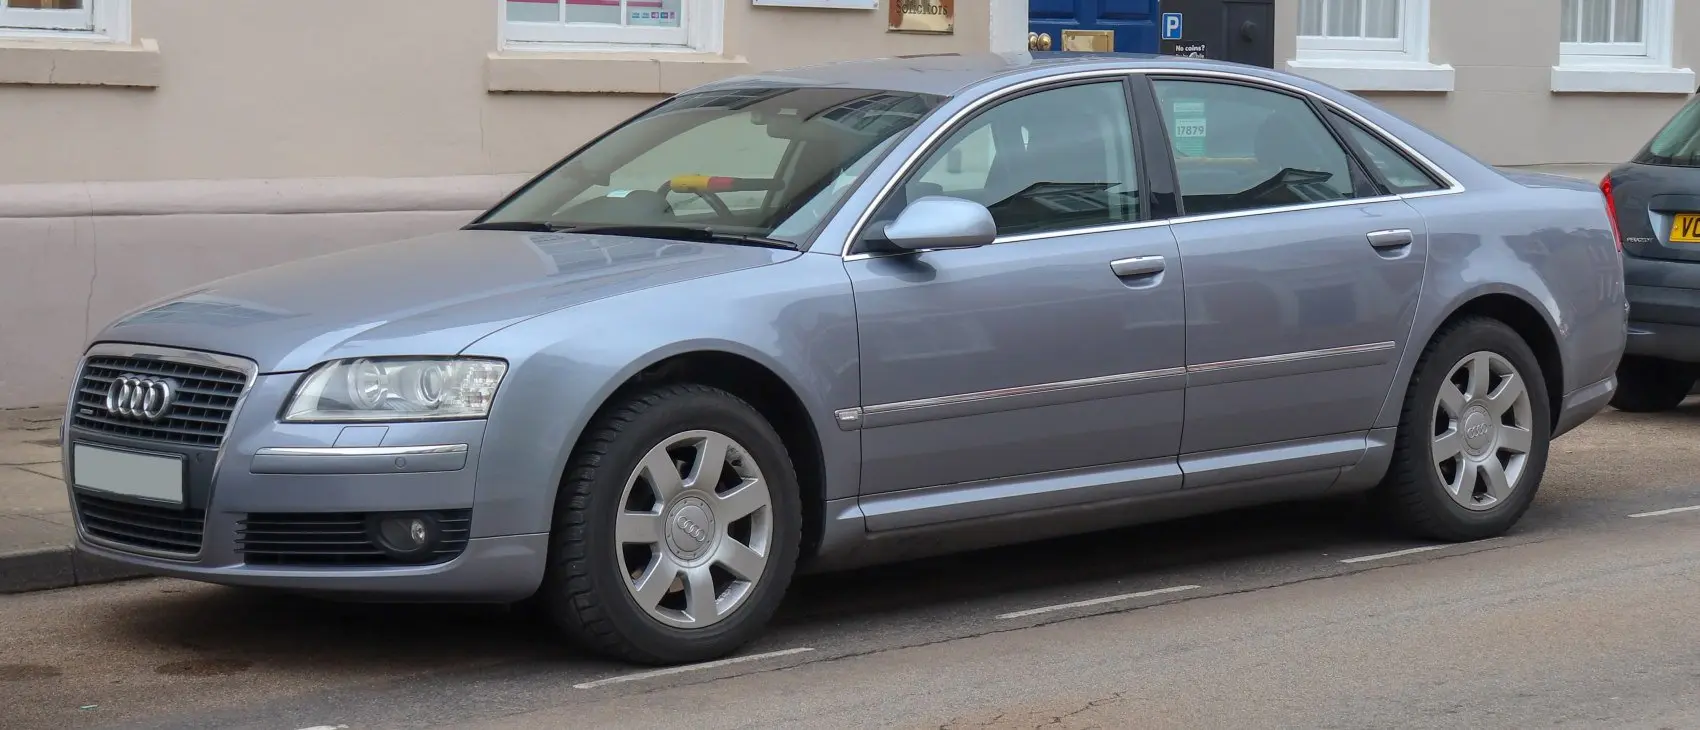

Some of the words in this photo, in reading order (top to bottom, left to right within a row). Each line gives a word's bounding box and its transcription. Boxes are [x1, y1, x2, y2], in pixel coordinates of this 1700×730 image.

[1166, 16, 1179, 37] P
[1185, 44, 1206, 52] coins?
[1176, 126, 1205, 136] 17879
